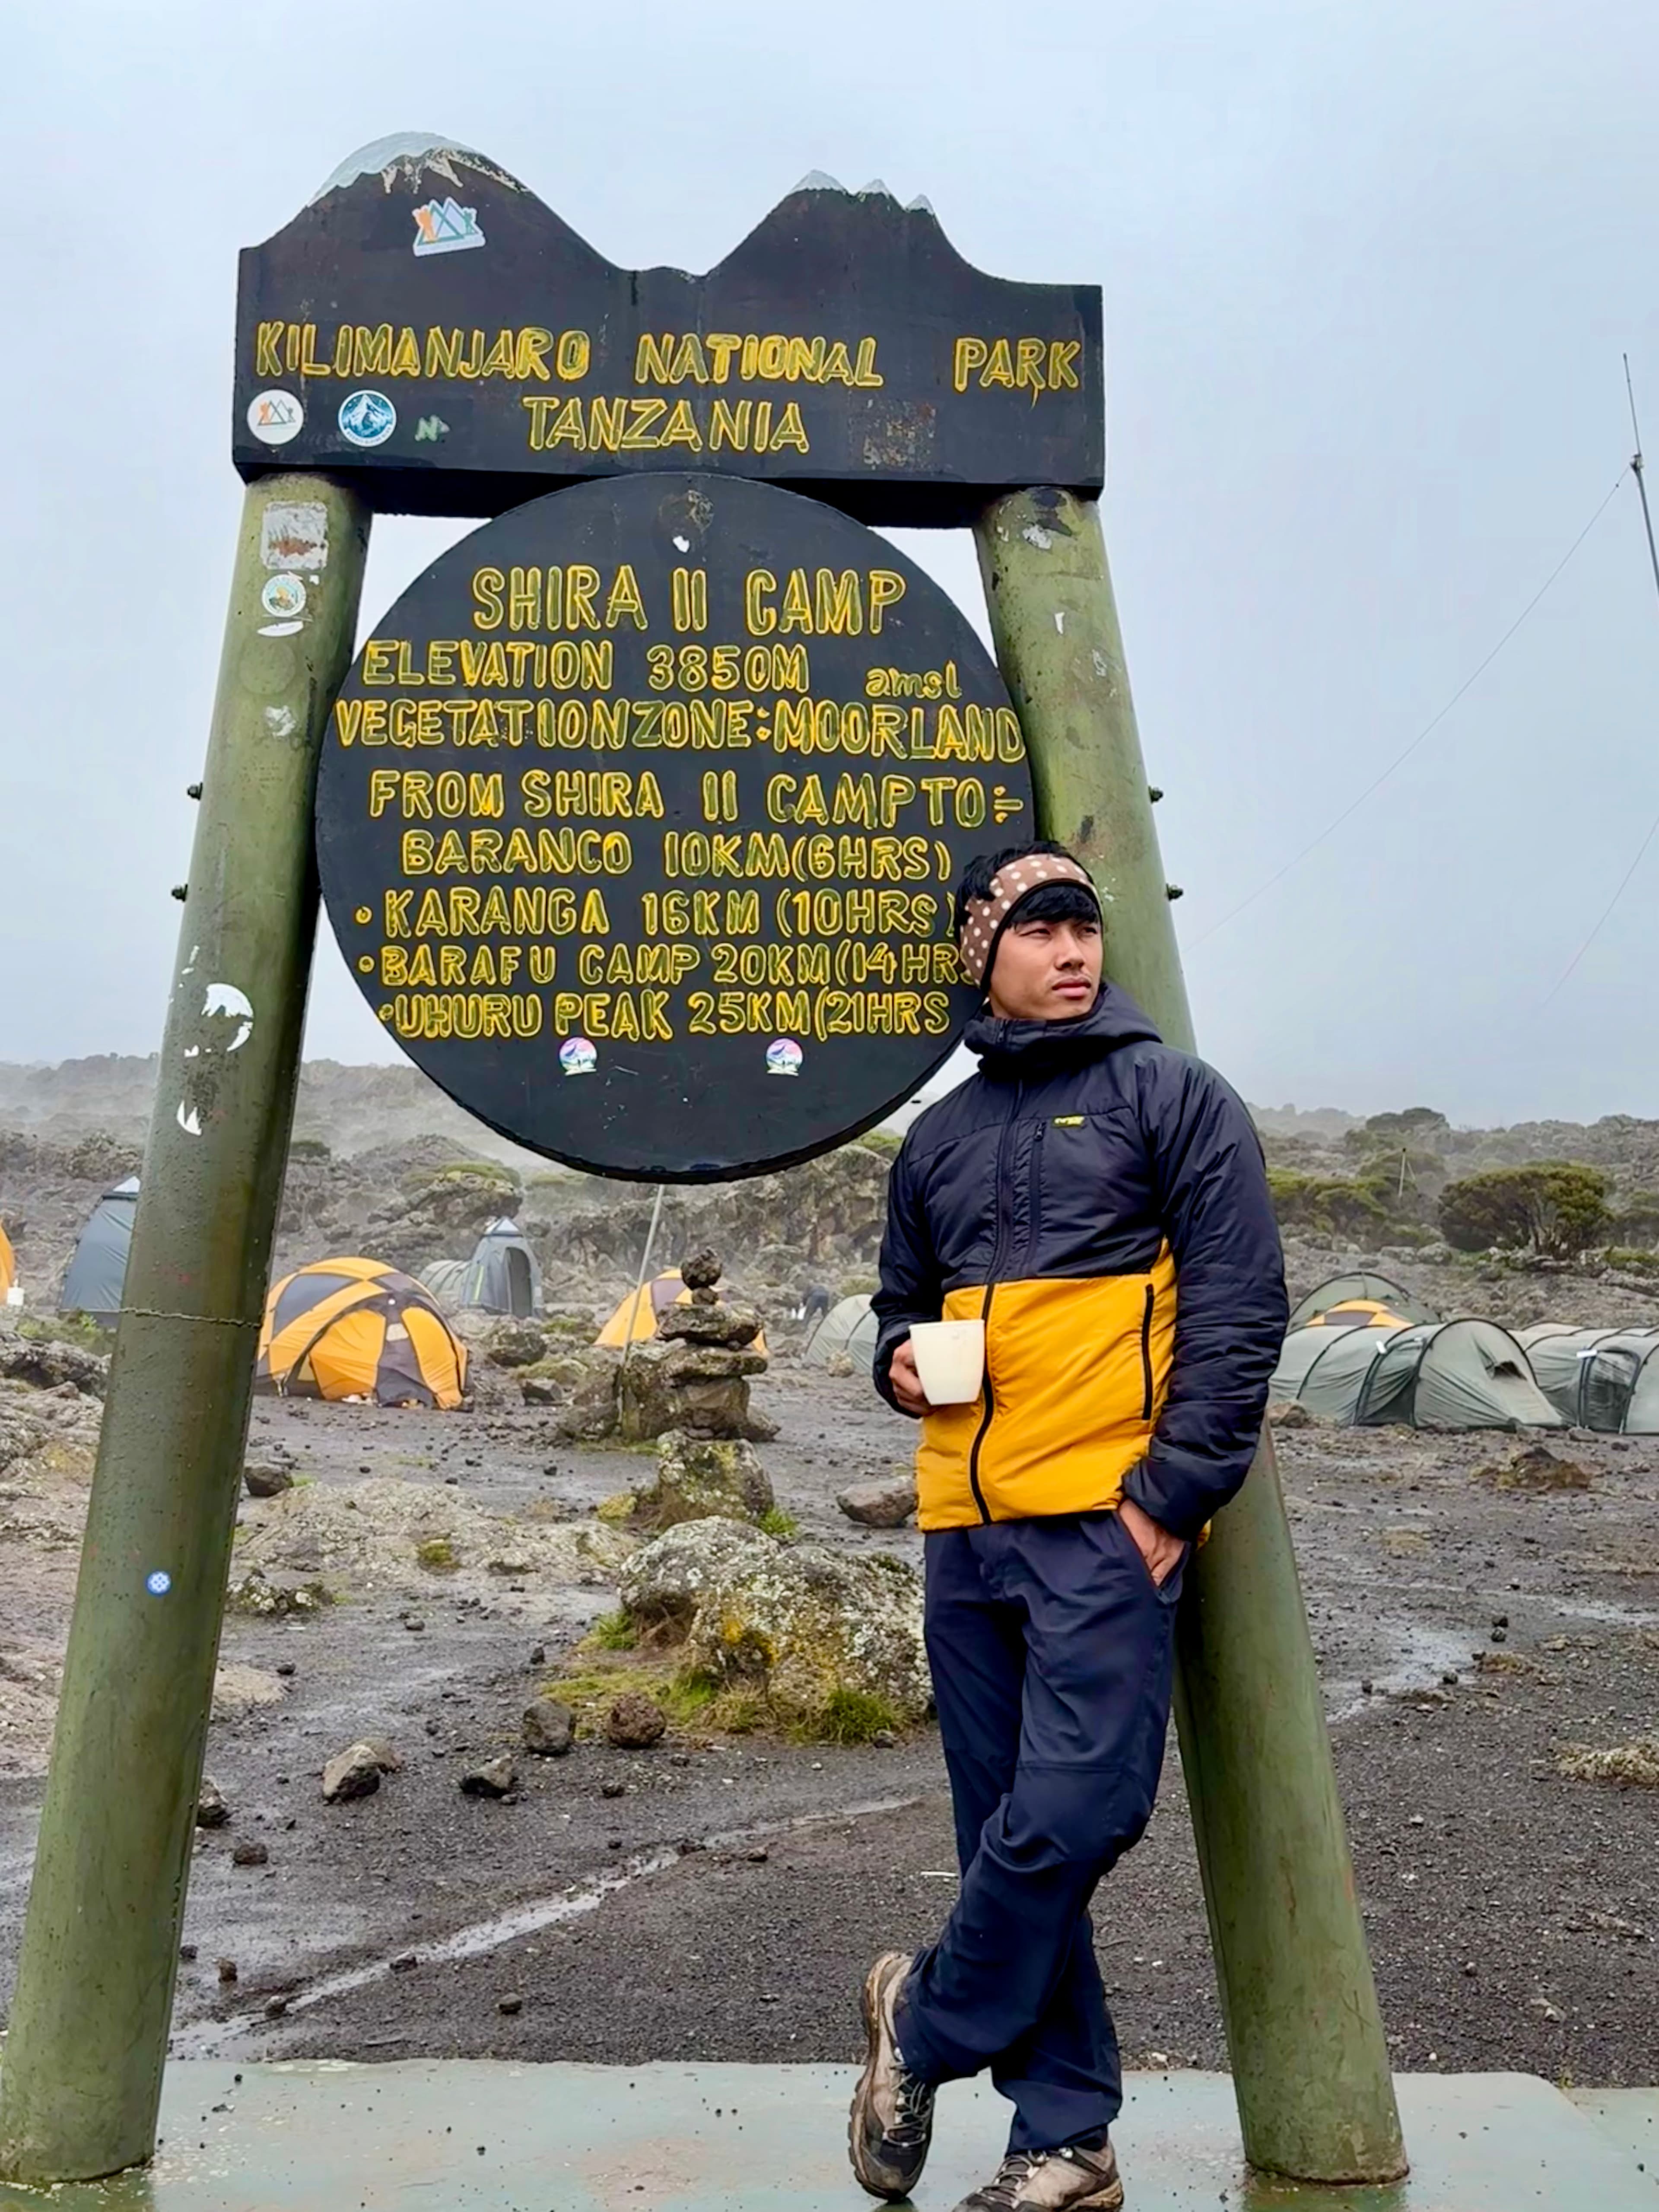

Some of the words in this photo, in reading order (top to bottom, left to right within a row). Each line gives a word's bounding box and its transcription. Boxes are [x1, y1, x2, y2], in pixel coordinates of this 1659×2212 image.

[257, 321, 589, 381] KILIMANJARO
[636, 334, 883, 386] NATIONAL
[954, 337, 1081, 391] PARK
[523, 397, 807, 453] TANZANIA
[473, 565, 646, 630] SHIRA
[747, 569, 906, 635] CAMP
[363, 639, 612, 690] ELEVATION
[647, 644, 808, 693] 3850M
[866, 661, 959, 699] amsl
[370, 770, 504, 819] FROM
[522, 769, 664, 818] SHIRA
[403, 828, 631, 874] BARANCO
[385, 886, 609, 938] KARANGA
[642, 890, 759, 935] 16KM
[381, 944, 555, 986] BARAFU
[580, 944, 700, 985] CAMP
[395, 994, 542, 1038] UHURU
[555, 989, 673, 1041] PEAK
